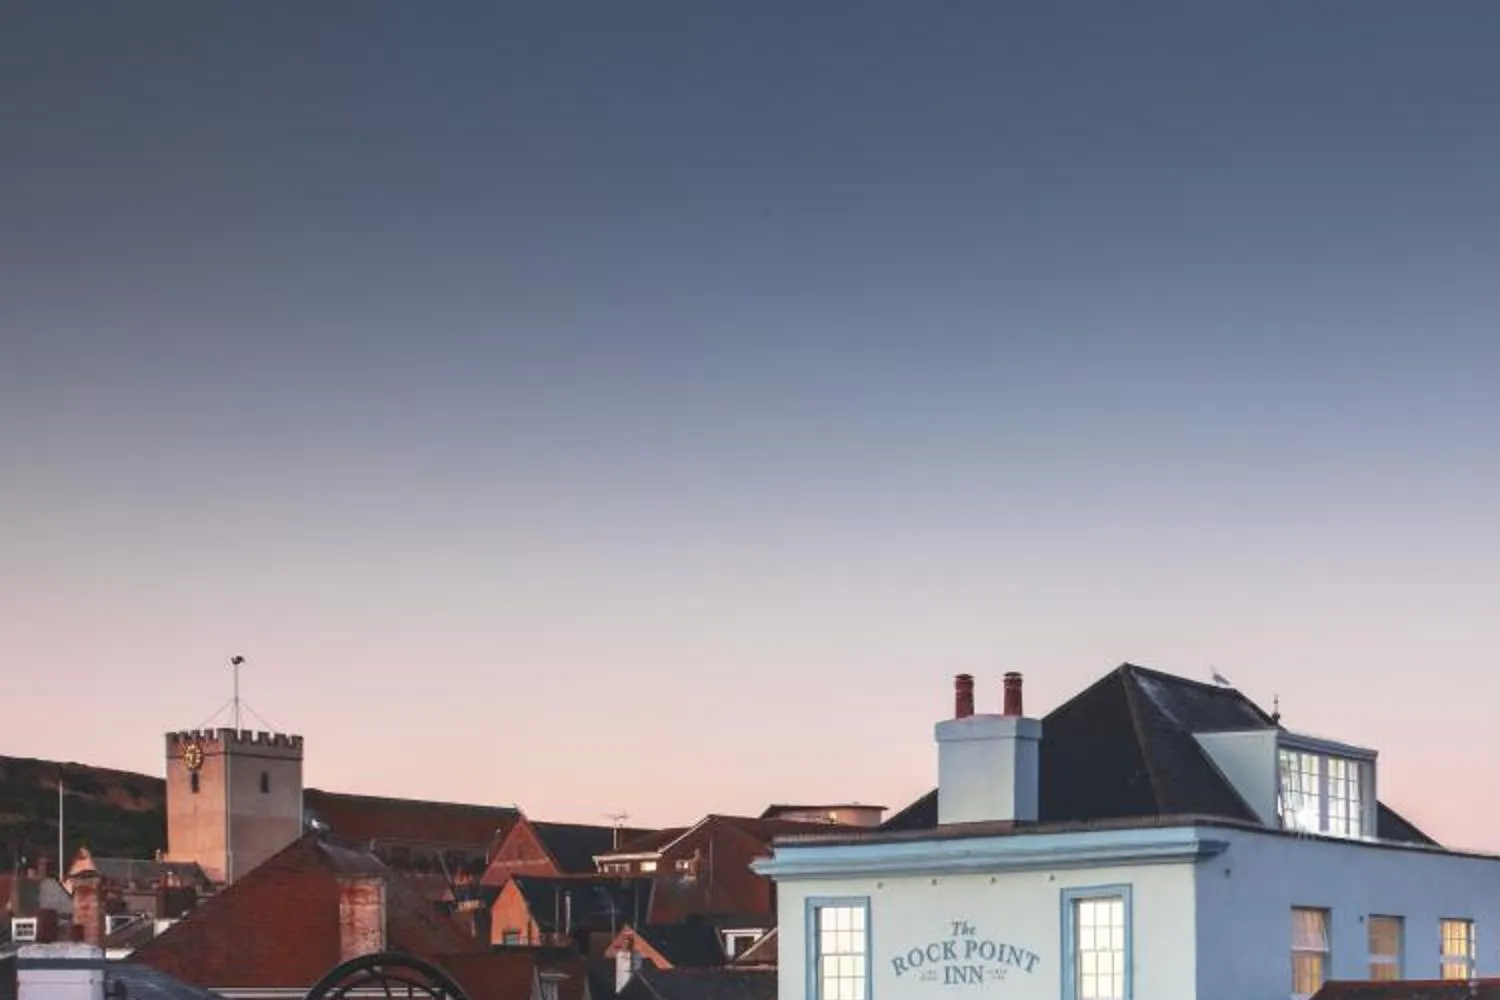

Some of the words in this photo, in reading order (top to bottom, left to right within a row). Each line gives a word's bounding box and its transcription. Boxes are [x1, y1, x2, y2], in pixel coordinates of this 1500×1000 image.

[951, 920, 976, 936] The
[890, 940, 957, 977] ROCK
[964, 939, 1040, 974] POINT
[943, 965, 984, 985] INN
